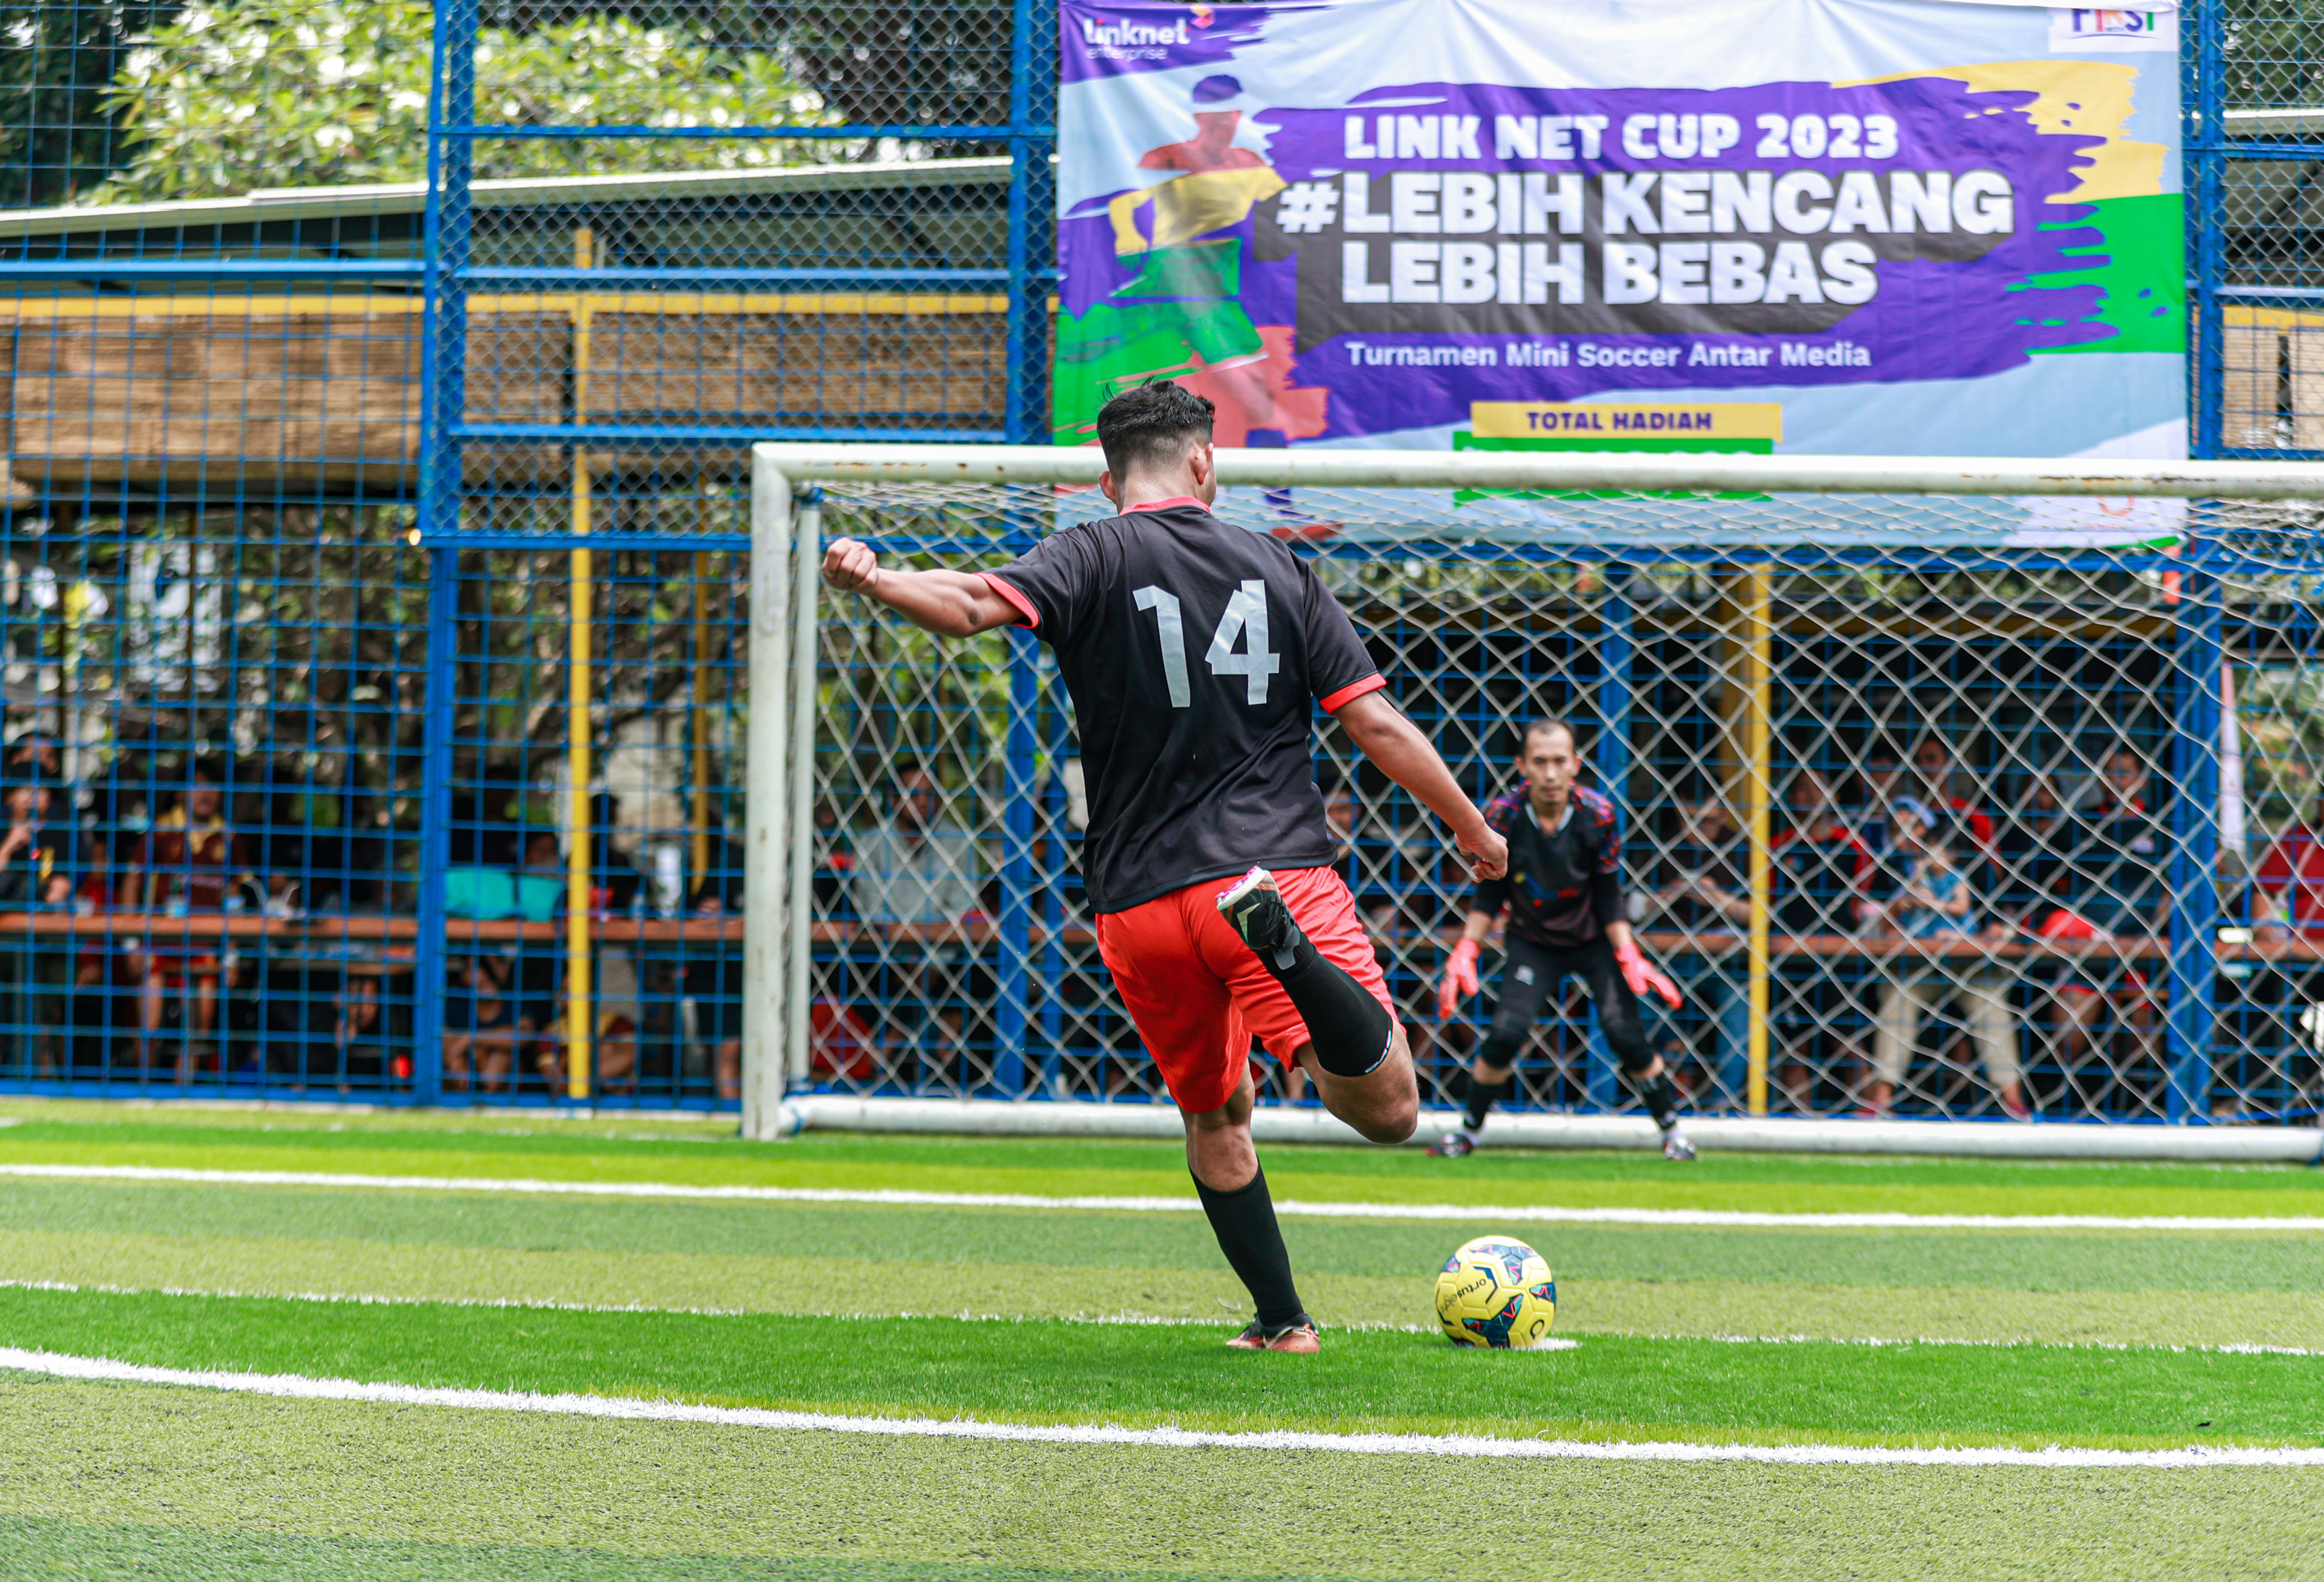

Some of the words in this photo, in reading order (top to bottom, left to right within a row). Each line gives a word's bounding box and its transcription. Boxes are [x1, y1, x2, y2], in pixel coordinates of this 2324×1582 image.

[1083, 17, 1191, 46] linknet
[1085, 46, 1168, 62] enterprise
[1344, 114, 1482, 160] LINK
[1495, 113, 1609, 160] NET
[1622, 113, 1741, 160] CUP
[1755, 113, 1899, 160] 2023
[1276, 171, 1585, 235] #LEBIH
[1601, 170, 2014, 236] KENCANG
[1342, 241, 1584, 304] LEBIH
[1602, 239, 1877, 305] BEBAS
[1346, 342, 1497, 367] Turnamen
[1506, 341, 1569, 367] Mini
[1578, 343, 1681, 368] Soccer
[1689, 342, 1773, 367] Antar
[1781, 341, 1871, 367] Media
[1528, 412, 1603, 430] TOTAL
[1613, 413, 1712, 430] HADIAH
[1132, 579, 1281, 708] 14
